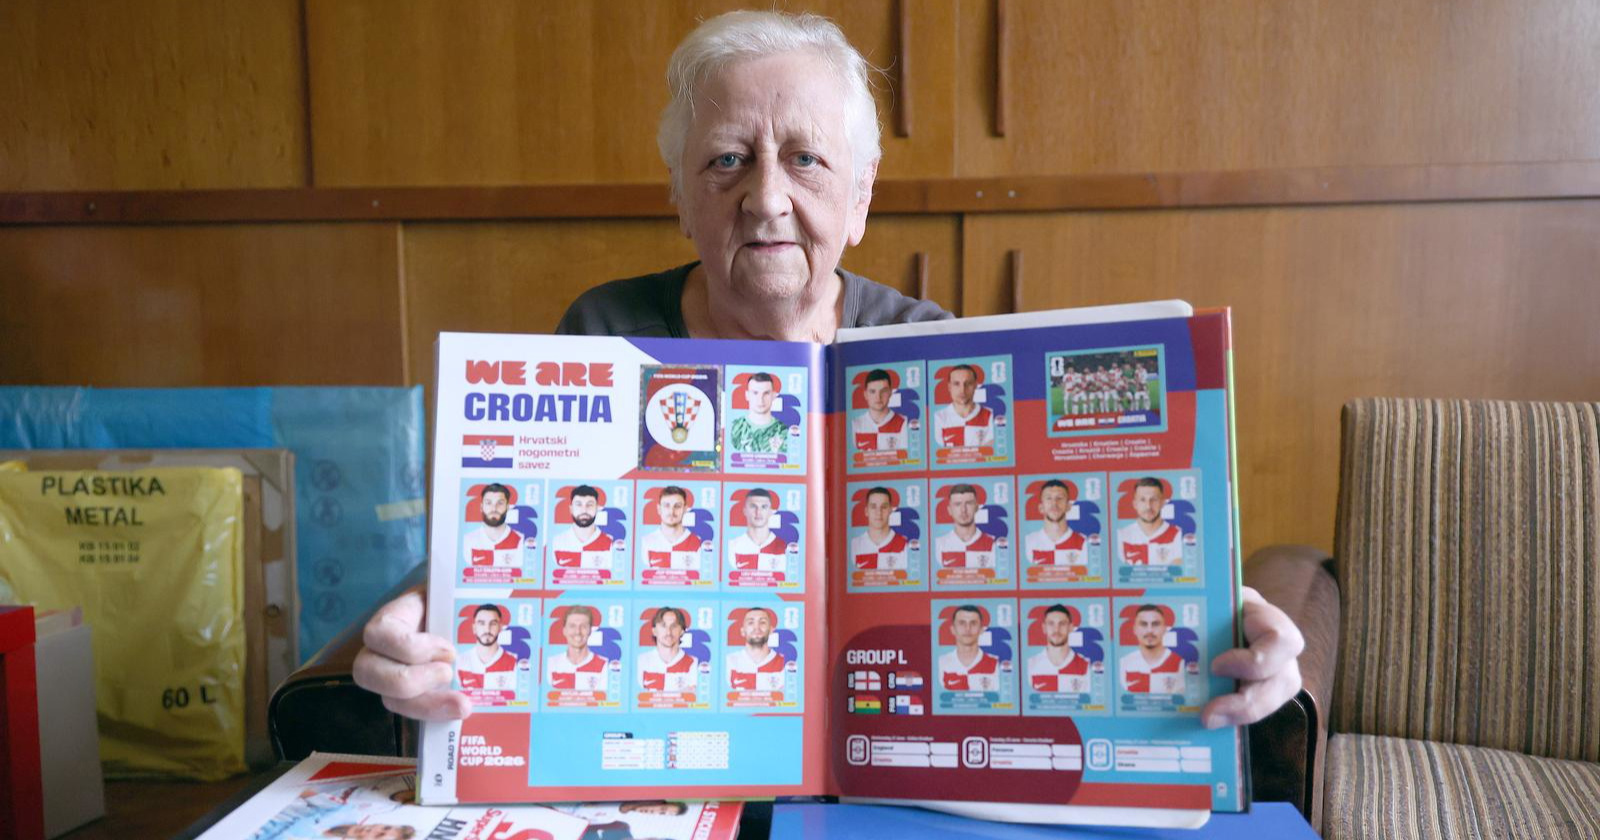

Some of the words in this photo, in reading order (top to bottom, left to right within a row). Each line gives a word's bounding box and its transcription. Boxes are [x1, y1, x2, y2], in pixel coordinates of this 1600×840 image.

[465, 360, 527, 386] WE
[464, 392, 613, 423] CROATIA
[519, 435, 567, 445] Hrvatski
[518, 448, 580, 459] nogometni
[518, 461, 550, 470] savez
[41, 476, 165, 496] PLASTIKA
[65, 507, 143, 526] METAL
[847, 649, 896, 665] GROUP
[898, 649, 908, 665] L
[162, 688, 189, 710] 60
[201, 685, 217, 704] L
[448, 731, 455, 743] TO
[461, 735, 486, 746] FIFA
[461, 746, 502, 756] WORLD
[460, 756, 483, 767] CUP
[484, 756, 525, 767] 2026
